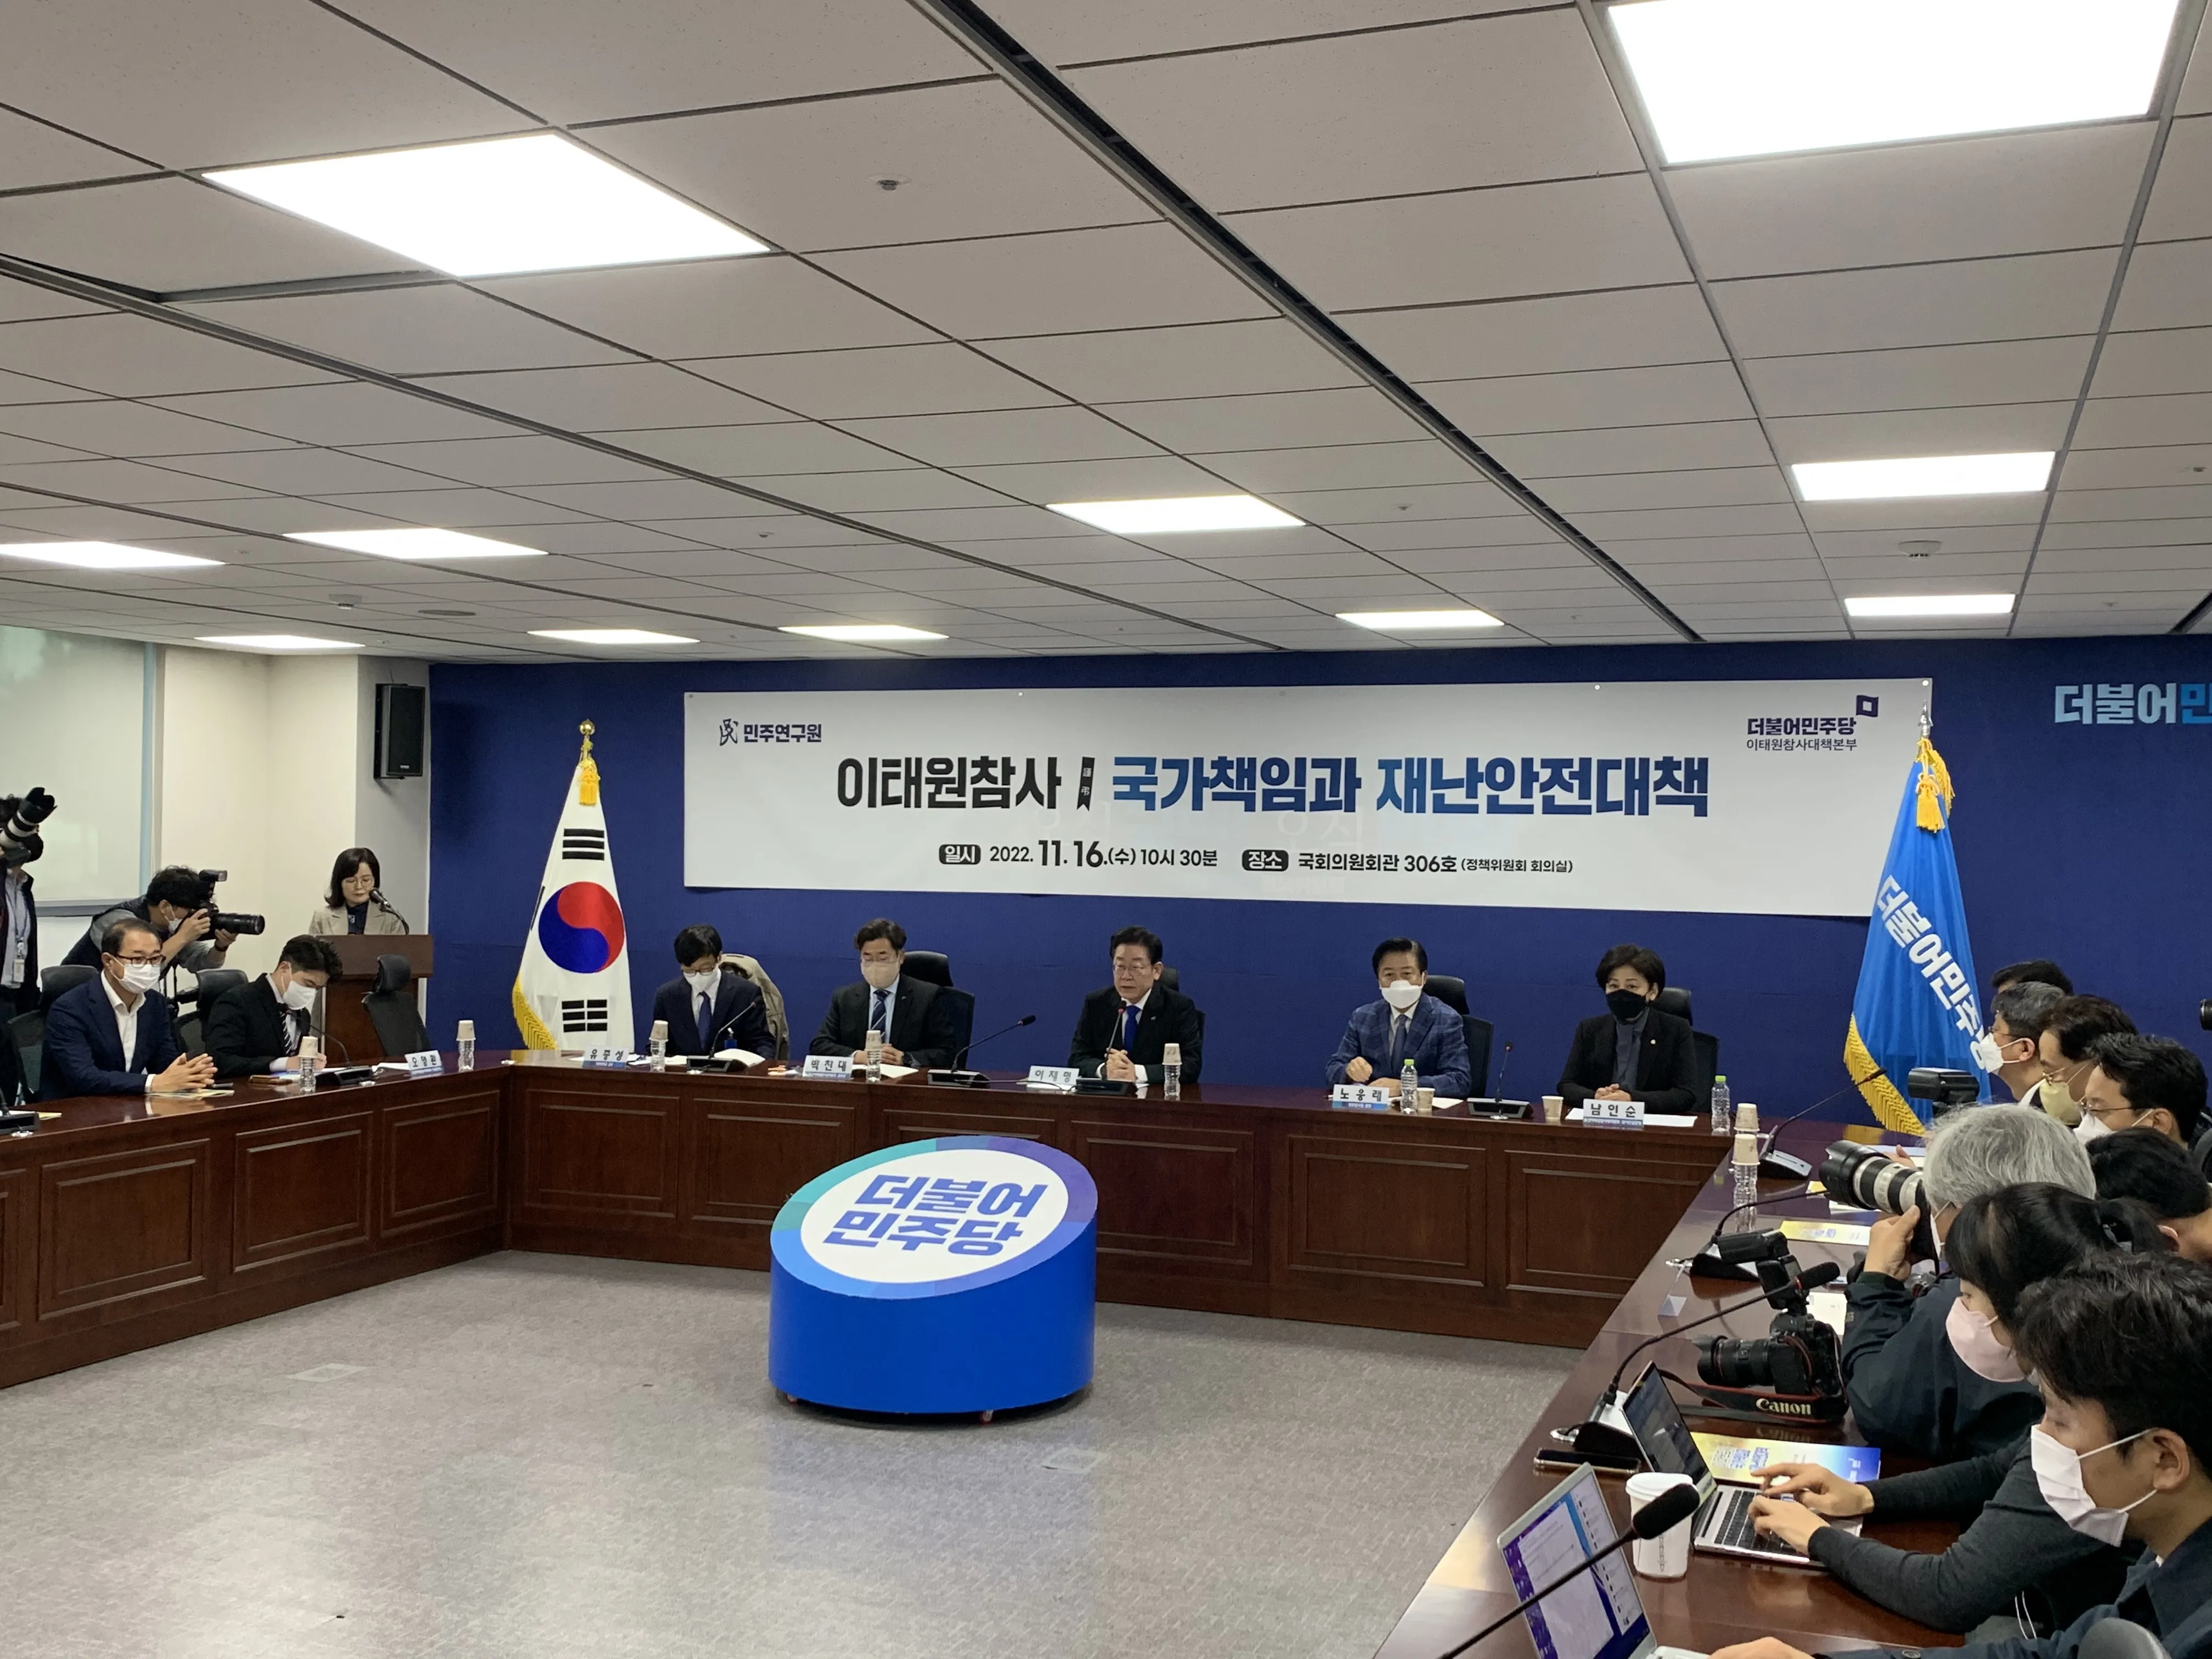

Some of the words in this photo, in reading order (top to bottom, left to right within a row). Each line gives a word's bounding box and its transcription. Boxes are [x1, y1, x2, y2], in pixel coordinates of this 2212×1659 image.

[743, 724, 822, 743] 민주연구원
[1747, 717, 1857, 736] 더불어민주당
[1746, 738, 1858, 751] 이태원참사대책본부
[837, 755, 1062, 810] 이태원참사
[1112, 755, 1362, 812] 국가책임과
[1376, 755, 1709, 817] 재난안전대책
[945, 845, 975, 864] 일시
[989, 846, 1034, 862] 2022.
[1141, 849, 1175, 866] 10시
[1180, 849, 1218, 867] 30분
[1248, 851, 1283, 870] 장소
[1298, 853, 1400, 872] 국회의원회관
[1403, 855, 1457, 872] 306호
[1461, 858, 1527, 872] (정책위원회
[1530, 859, 1573, 873] 회의실)
[854, 1174, 1048, 1218] 더불어
[822, 1210, 1024, 1256] 민주당
[1756, 1397, 1812, 1416] Canon
